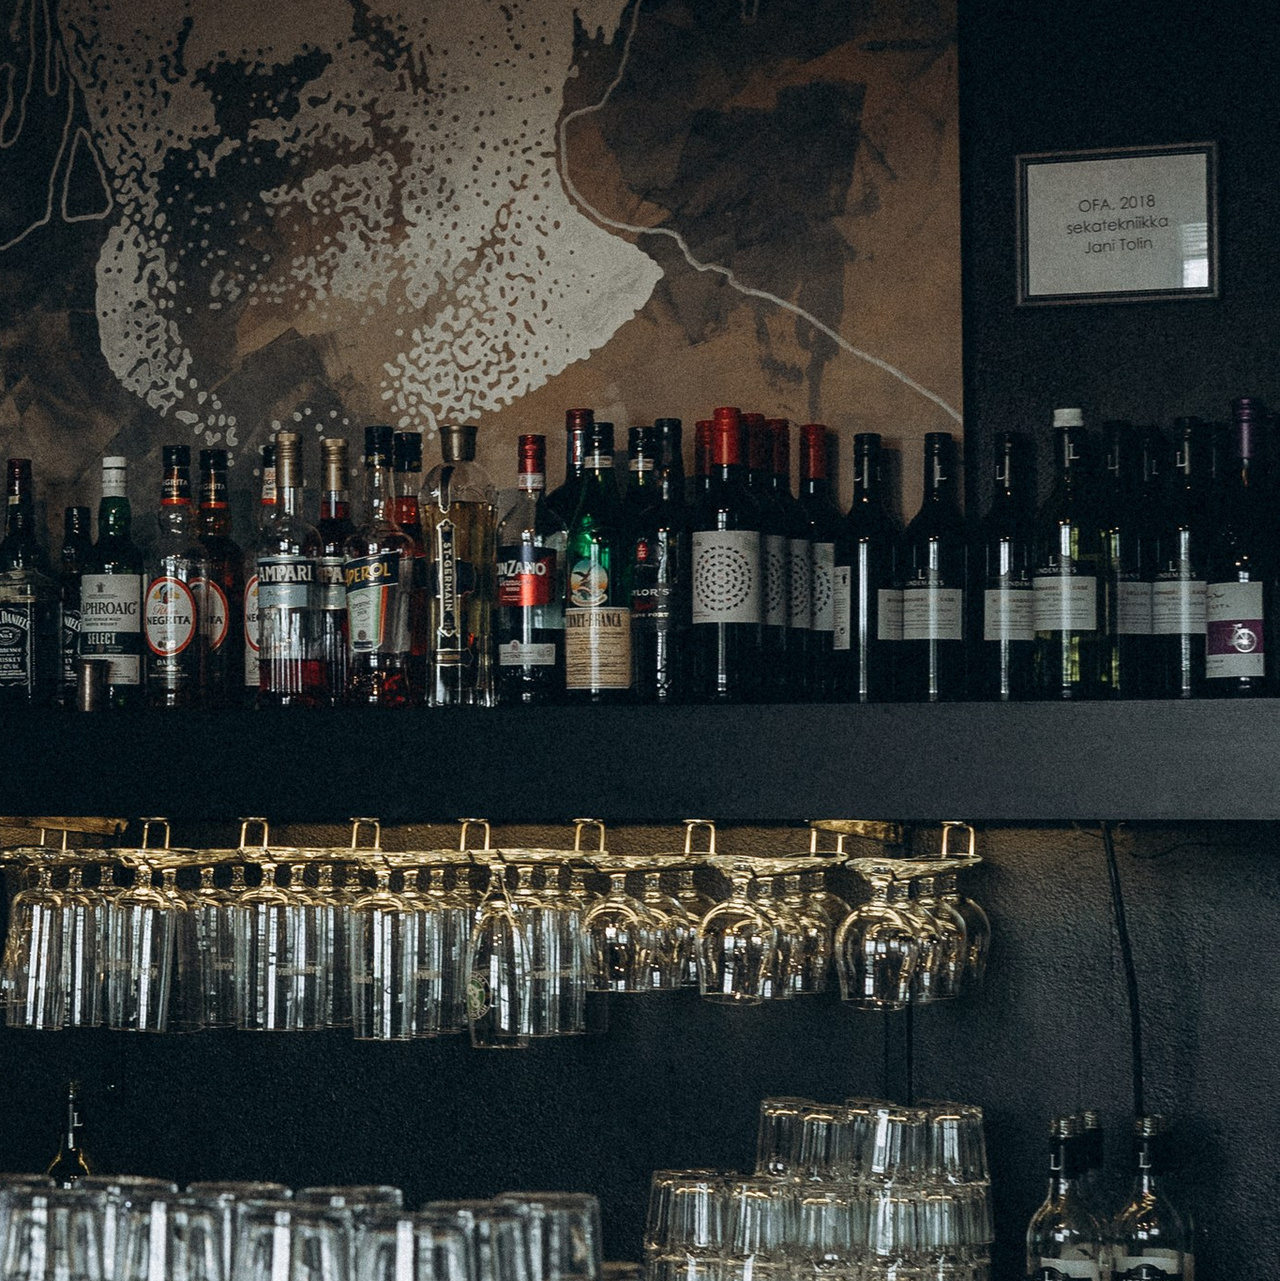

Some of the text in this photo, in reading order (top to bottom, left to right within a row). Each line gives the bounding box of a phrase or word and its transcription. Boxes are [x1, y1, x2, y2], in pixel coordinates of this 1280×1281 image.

[1120, 194, 1156, 210] 2018
[1066, 215, 1169, 235] sekatekniikka
[1084, 236, 1153, 254] Jani Tolin
[258, 564, 315, 582] AMPARI
[497, 560, 547, 577] INZANO
[442, 542, 452, 613] ST-GERMAIN
[87, 632, 117, 645] SELECT
[1050, 1153, 1062, 1170] L
[1139, 1152, 1152, 1168] L
[1141, 1268, 1152, 1280] L
